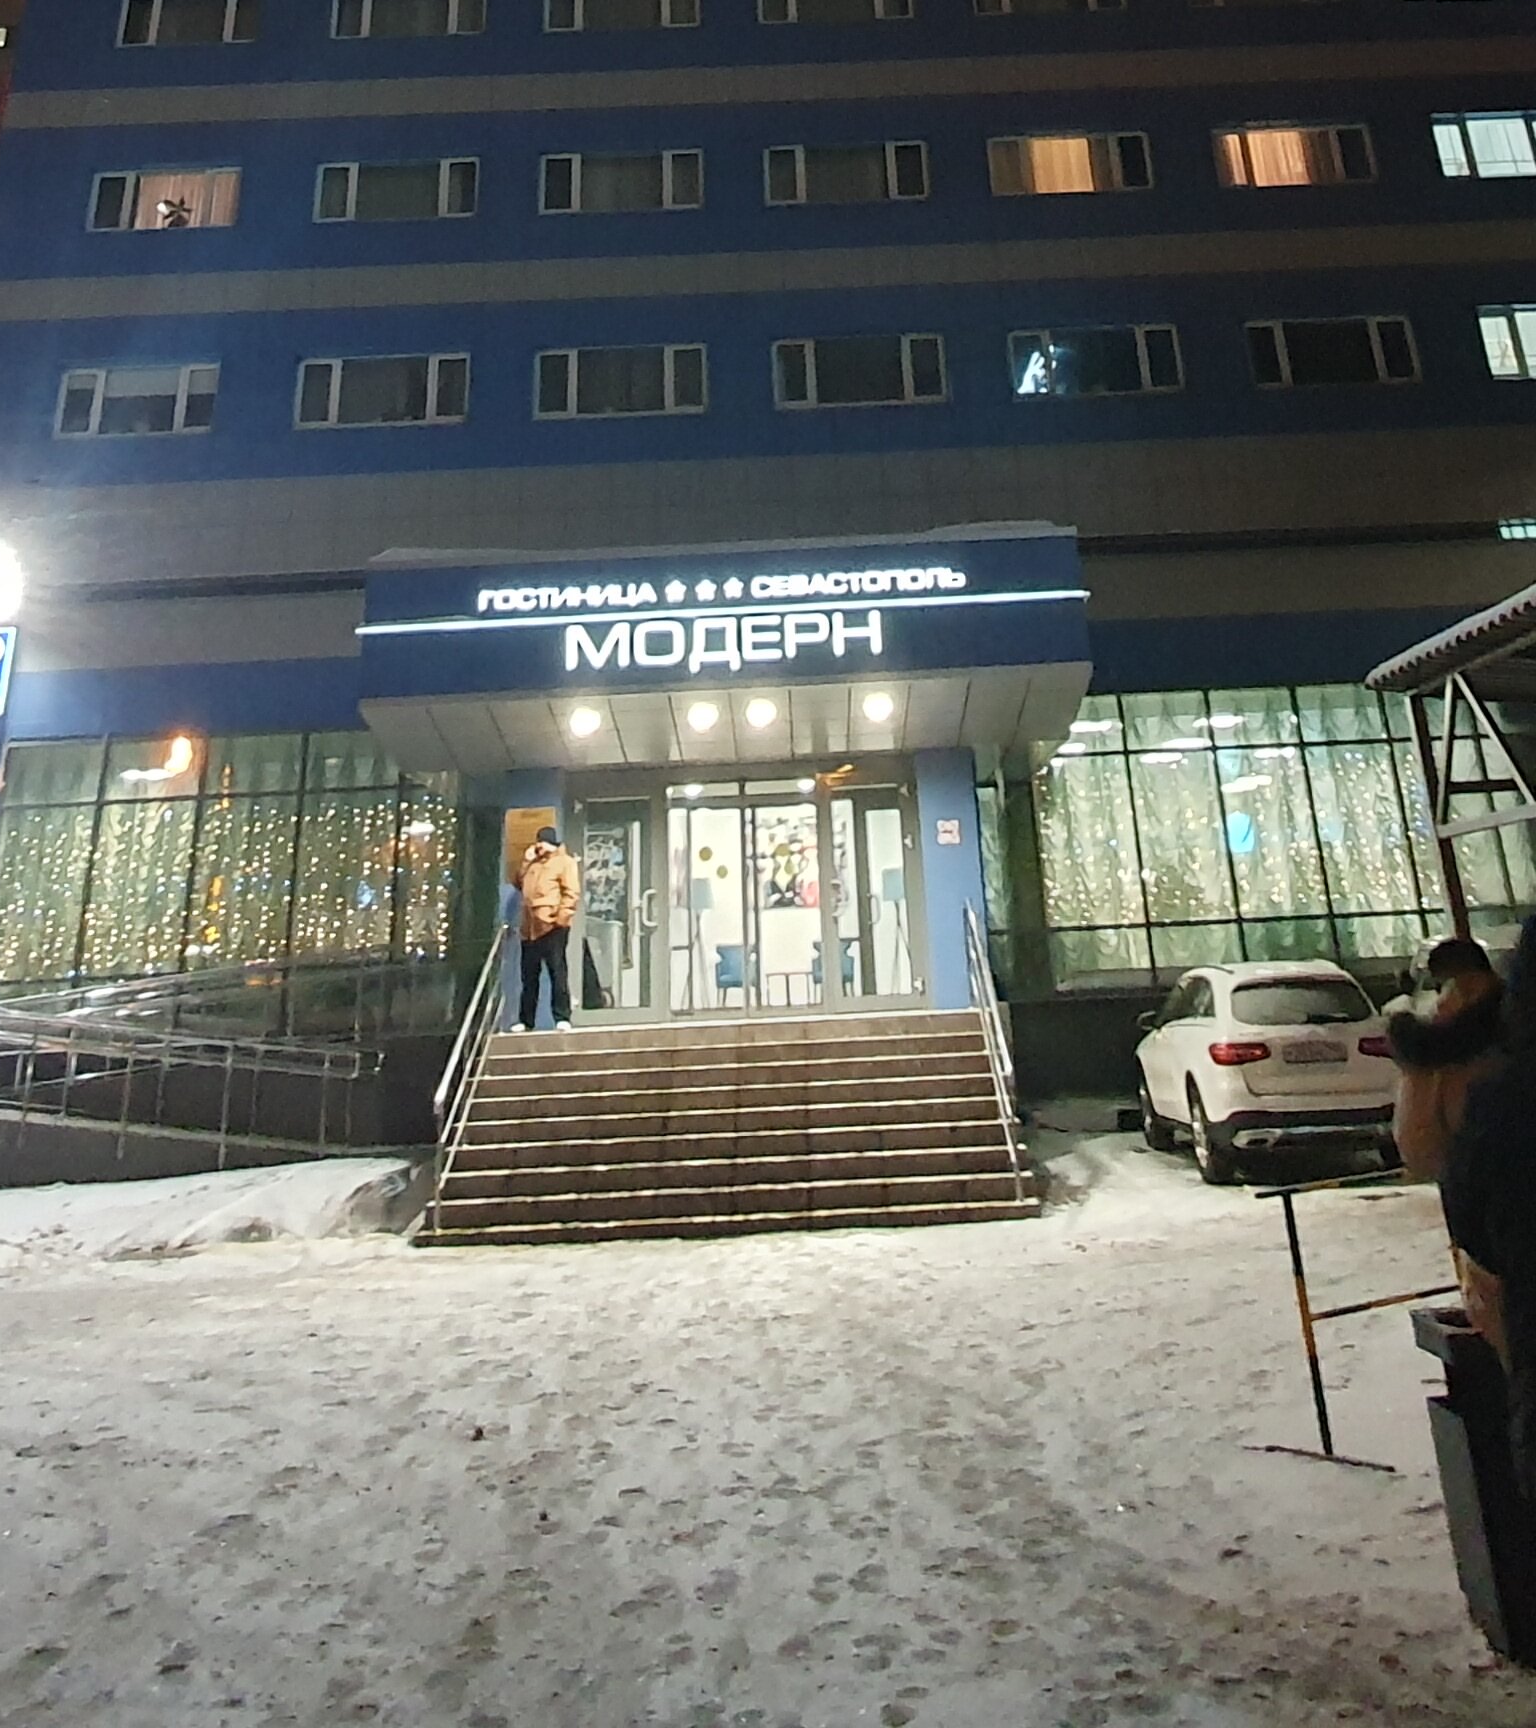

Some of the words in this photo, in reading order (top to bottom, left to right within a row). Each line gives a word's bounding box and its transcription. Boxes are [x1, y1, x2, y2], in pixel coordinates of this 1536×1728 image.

[477, 581, 658, 613] ГОСТИНИЦА
[750, 567, 966, 600] СЕВАСТОПОЛЬ
[565, 609, 883, 674] МОДЕРН
